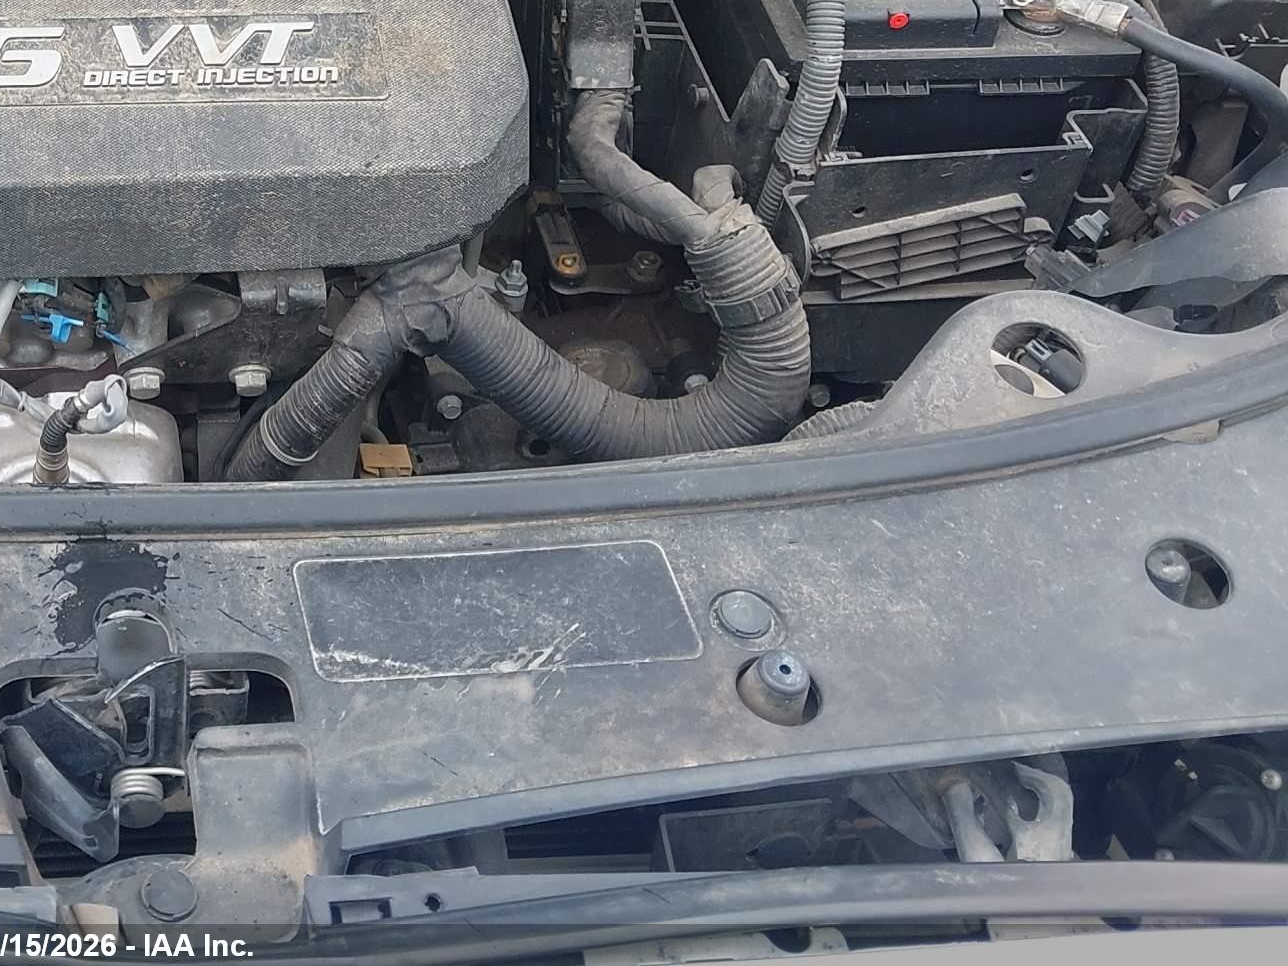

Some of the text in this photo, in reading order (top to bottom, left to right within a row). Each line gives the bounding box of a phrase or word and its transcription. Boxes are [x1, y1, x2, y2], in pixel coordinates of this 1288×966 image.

[111, 21, 316, 67] VVT
[83, 65, 339, 87] DIRECT INJECTION
